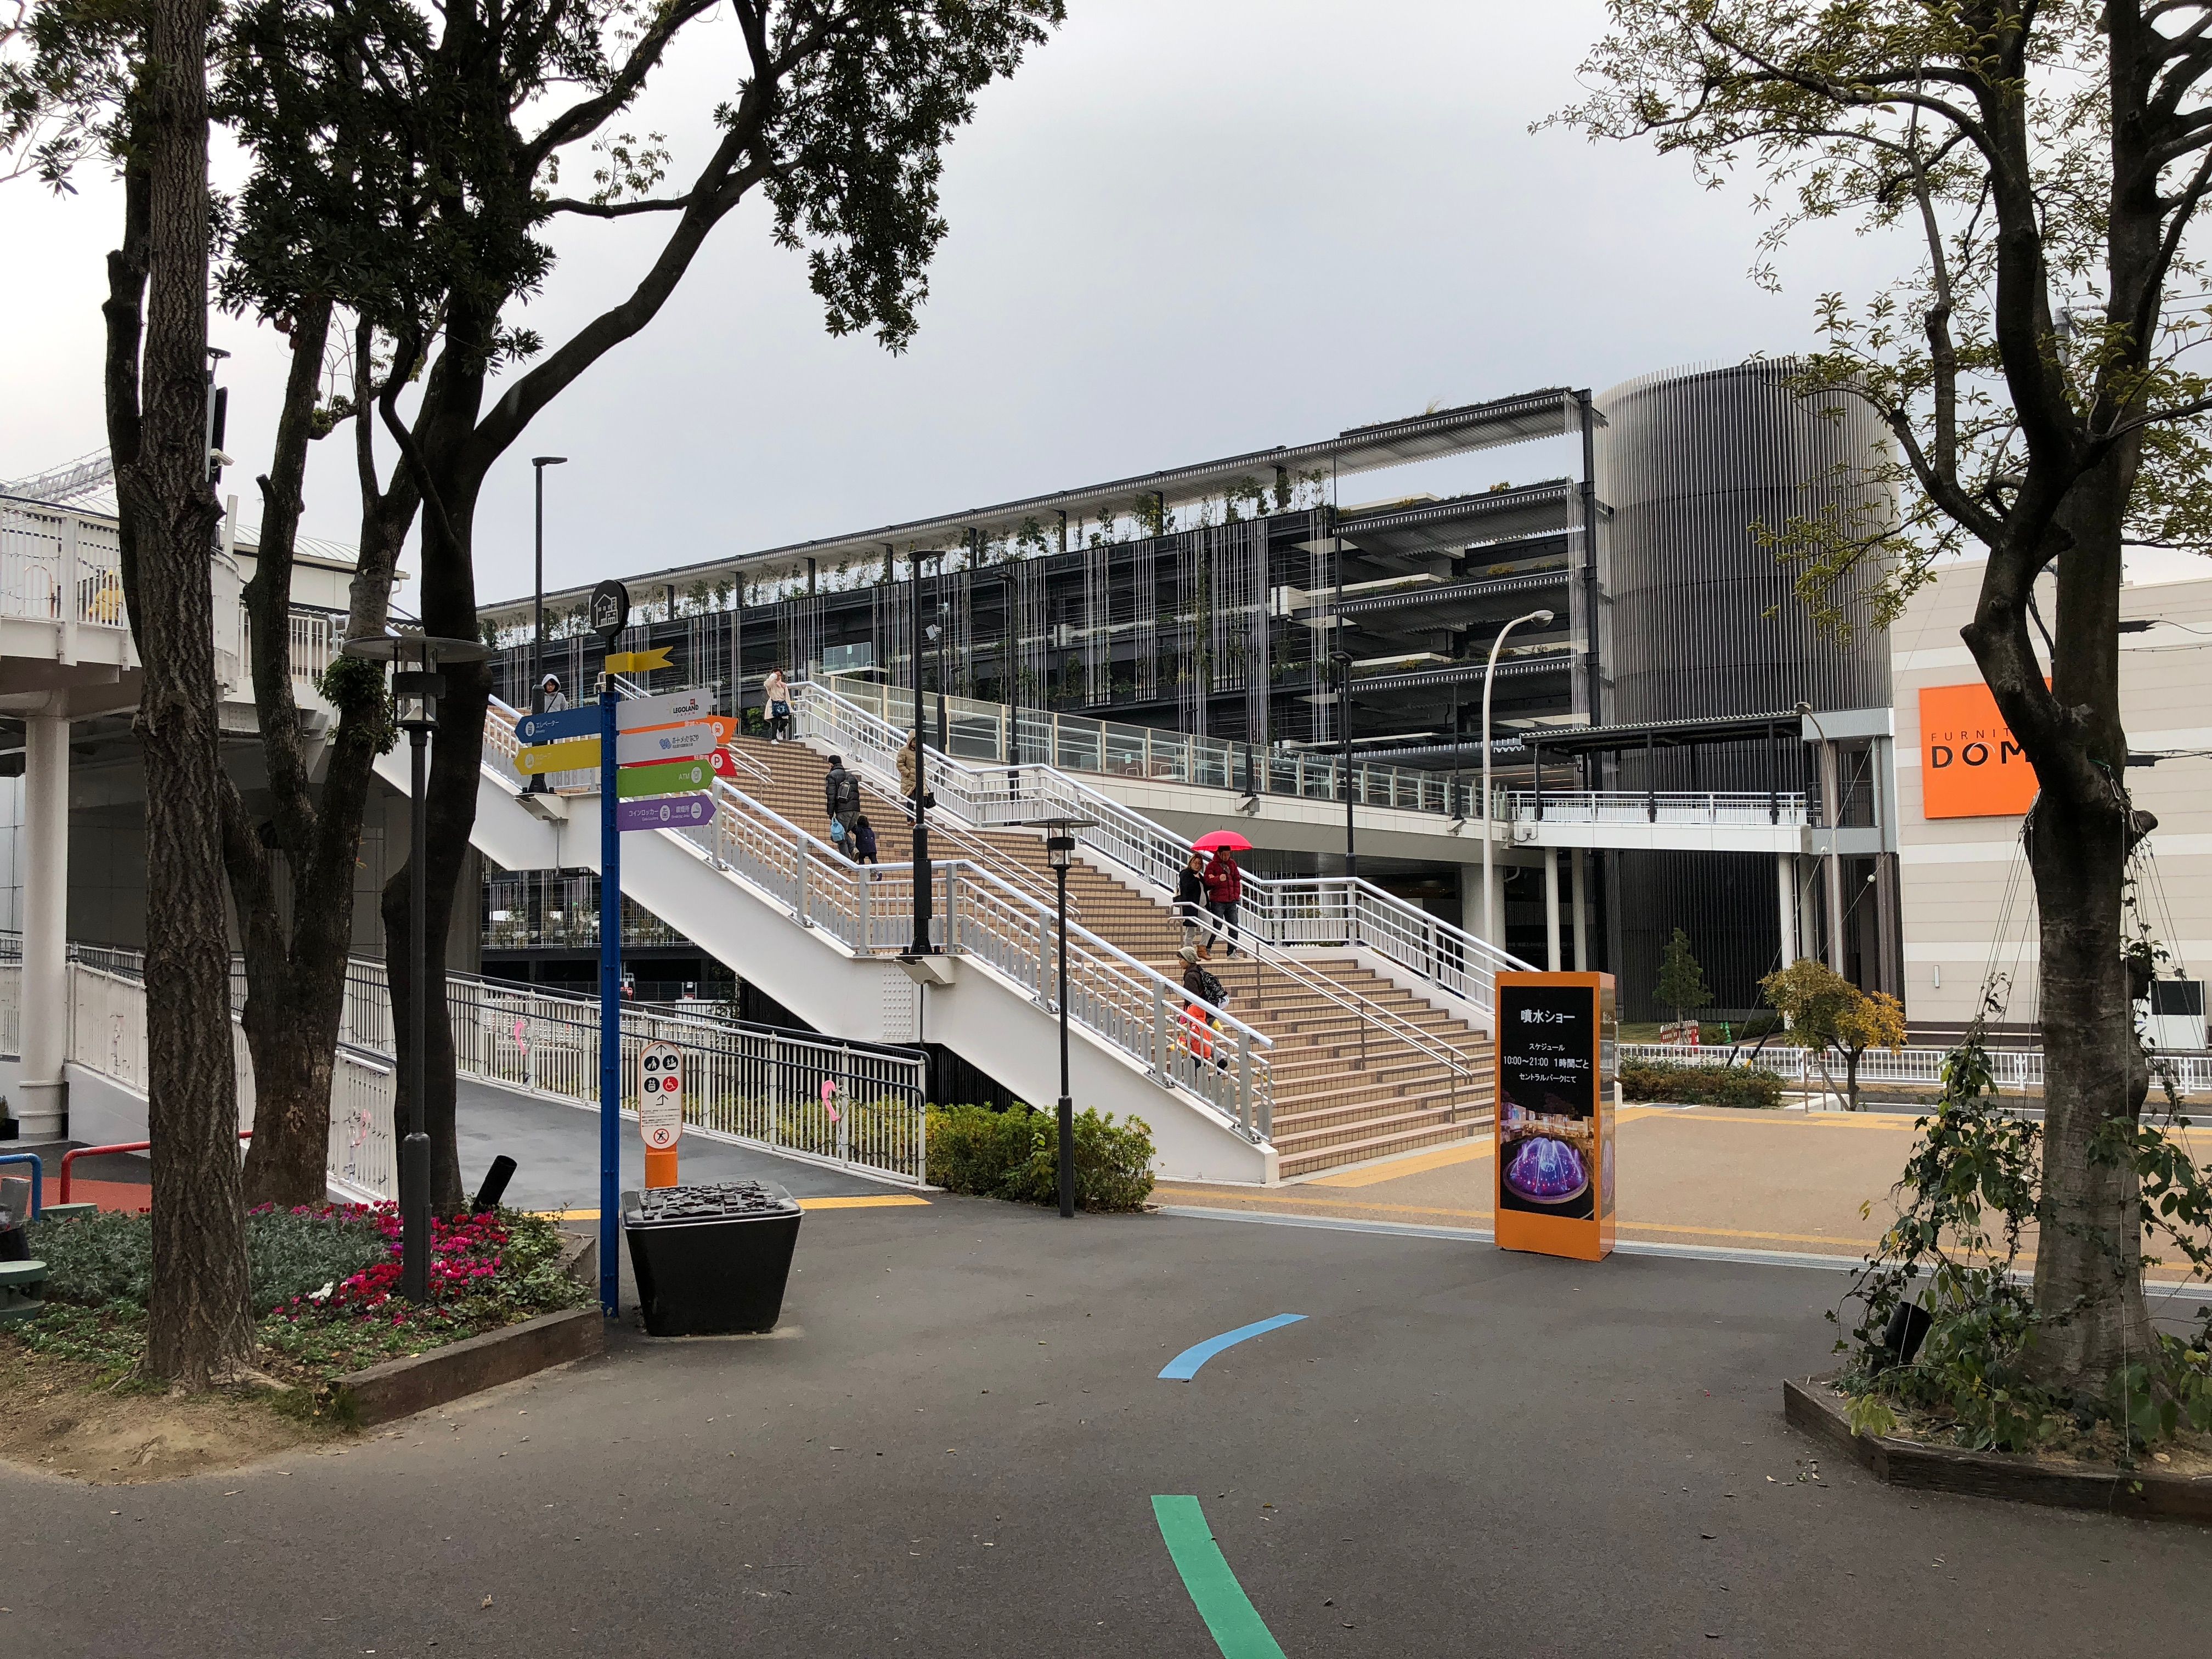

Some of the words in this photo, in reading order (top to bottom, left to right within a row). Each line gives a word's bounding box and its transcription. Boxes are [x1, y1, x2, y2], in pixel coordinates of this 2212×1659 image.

[673, 704, 699, 714] LEGOLAND
[535, 720, 560, 729] エレベーター
[714, 757, 720, 765] P
[629, 809, 658, 817] コインロッカー
[1520, 1009, 1575, 1024] 噴水ショー
[1529, 1043, 1565, 1051] スケジュール
[1554, 1058, 1589, 1069] 1時間ごと
[1519, 1073, 1577, 1084] セントラルパークにて
